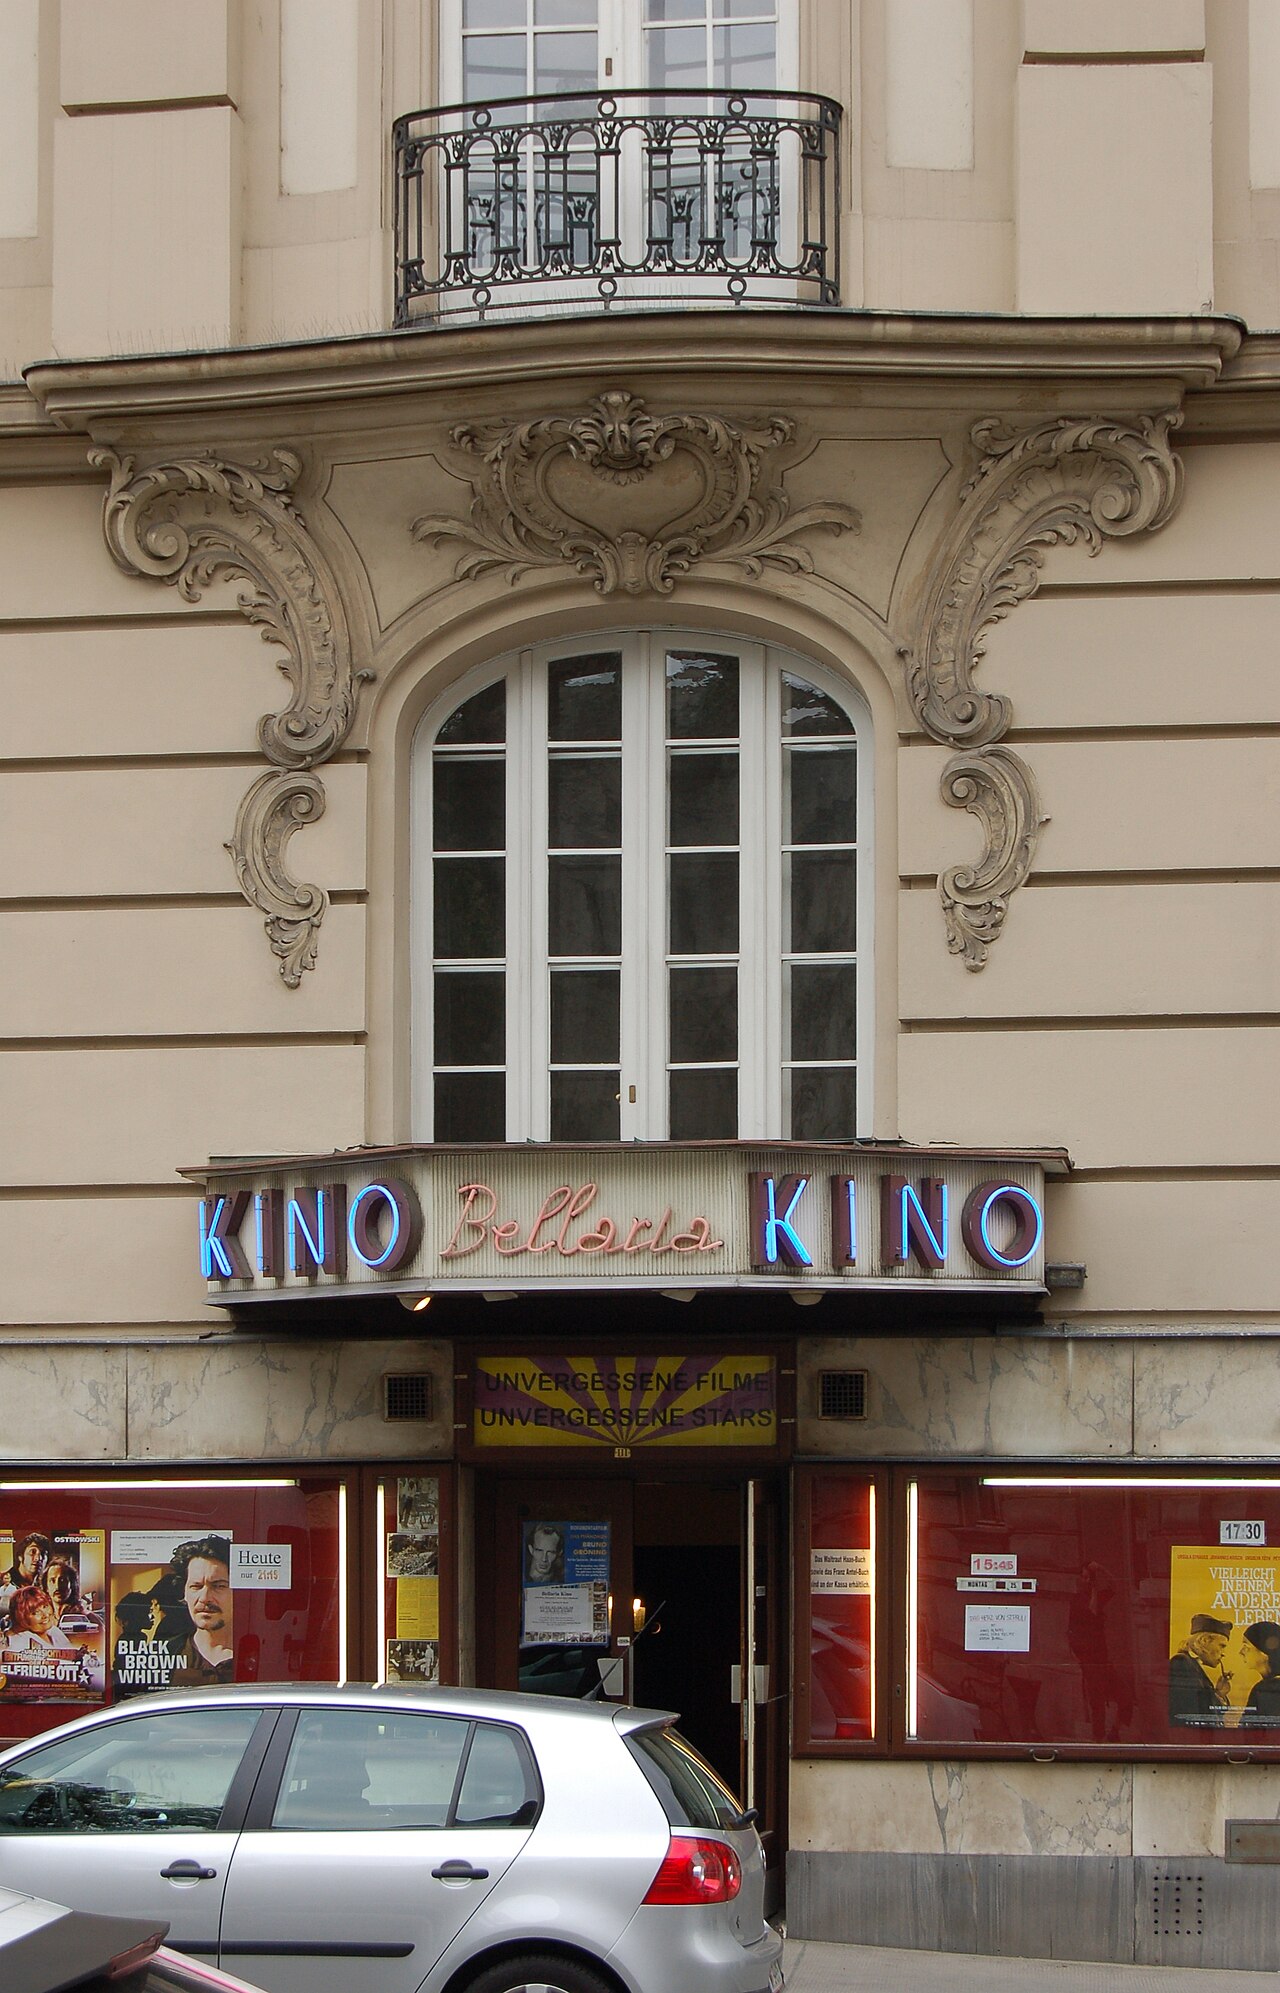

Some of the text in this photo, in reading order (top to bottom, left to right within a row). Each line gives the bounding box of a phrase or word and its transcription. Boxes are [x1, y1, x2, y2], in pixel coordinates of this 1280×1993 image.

[438, 1183, 725, 1256] Bellaria
[750, 1171, 1043, 1272] KINO
[199, 1177, 424, 1281] KINO
[484, 1372, 769, 1392] UNVERGESSENE FILME
[480, 1407, 772, 1427] UNVERGESSENE STARS
[239, 1550, 281, 1564] Heute
[973, 1558, 1014, 1571] 15:45
[1209, 1567, 1276, 1580] VIELLEICHT
[1220, 1579, 1274, 1592] IN EINEM
[118, 1640, 169, 1655] BLACK
[125, 1654, 188, 1669] BROWN
[0, 1664, 79, 1682] ELFRIEDE OTT
[118, 1669, 170, 1684] WHITE
